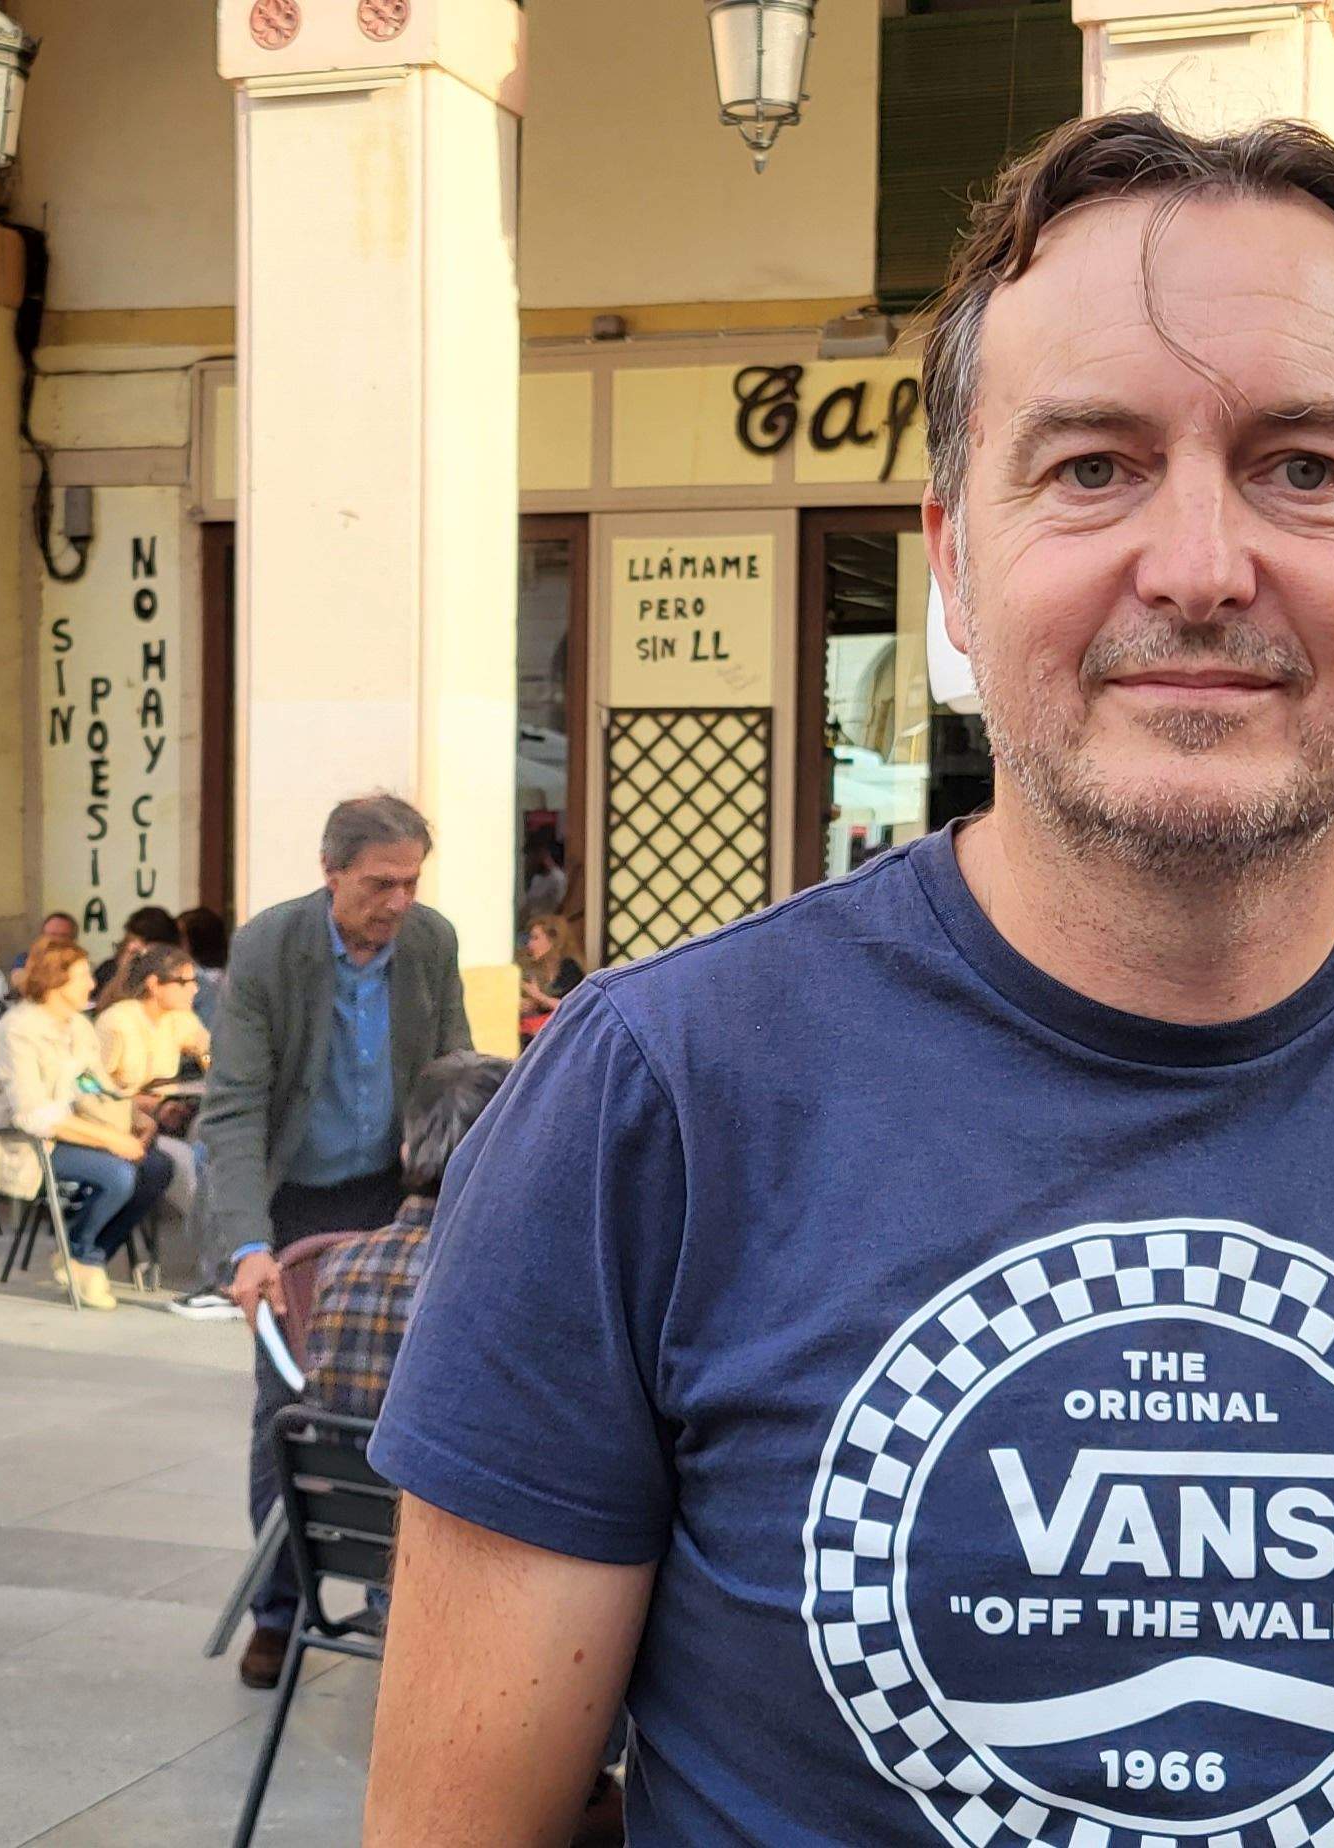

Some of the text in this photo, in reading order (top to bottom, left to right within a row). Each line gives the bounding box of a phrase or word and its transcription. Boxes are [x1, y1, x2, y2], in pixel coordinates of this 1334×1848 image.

[733, 364, 920, 483] Caf
[628, 547, 760, 582] LLÁMAME
[639, 597, 705, 621] PERO
[636, 630, 729, 662] SIN LL
[49, 618, 74, 747] SIN
[132, 537, 166, 899] NO HAY CIU
[83, 677, 112, 934] POESIA
[1123, 1351, 1206, 1382] THE
[1064, 1390, 1279, 1423] ORIGINAL
[950, 1595, 1083, 1636] "OFF
[1097, 1599, 1200, 1638] THE
[1099, 1749, 1226, 1792] 1966
